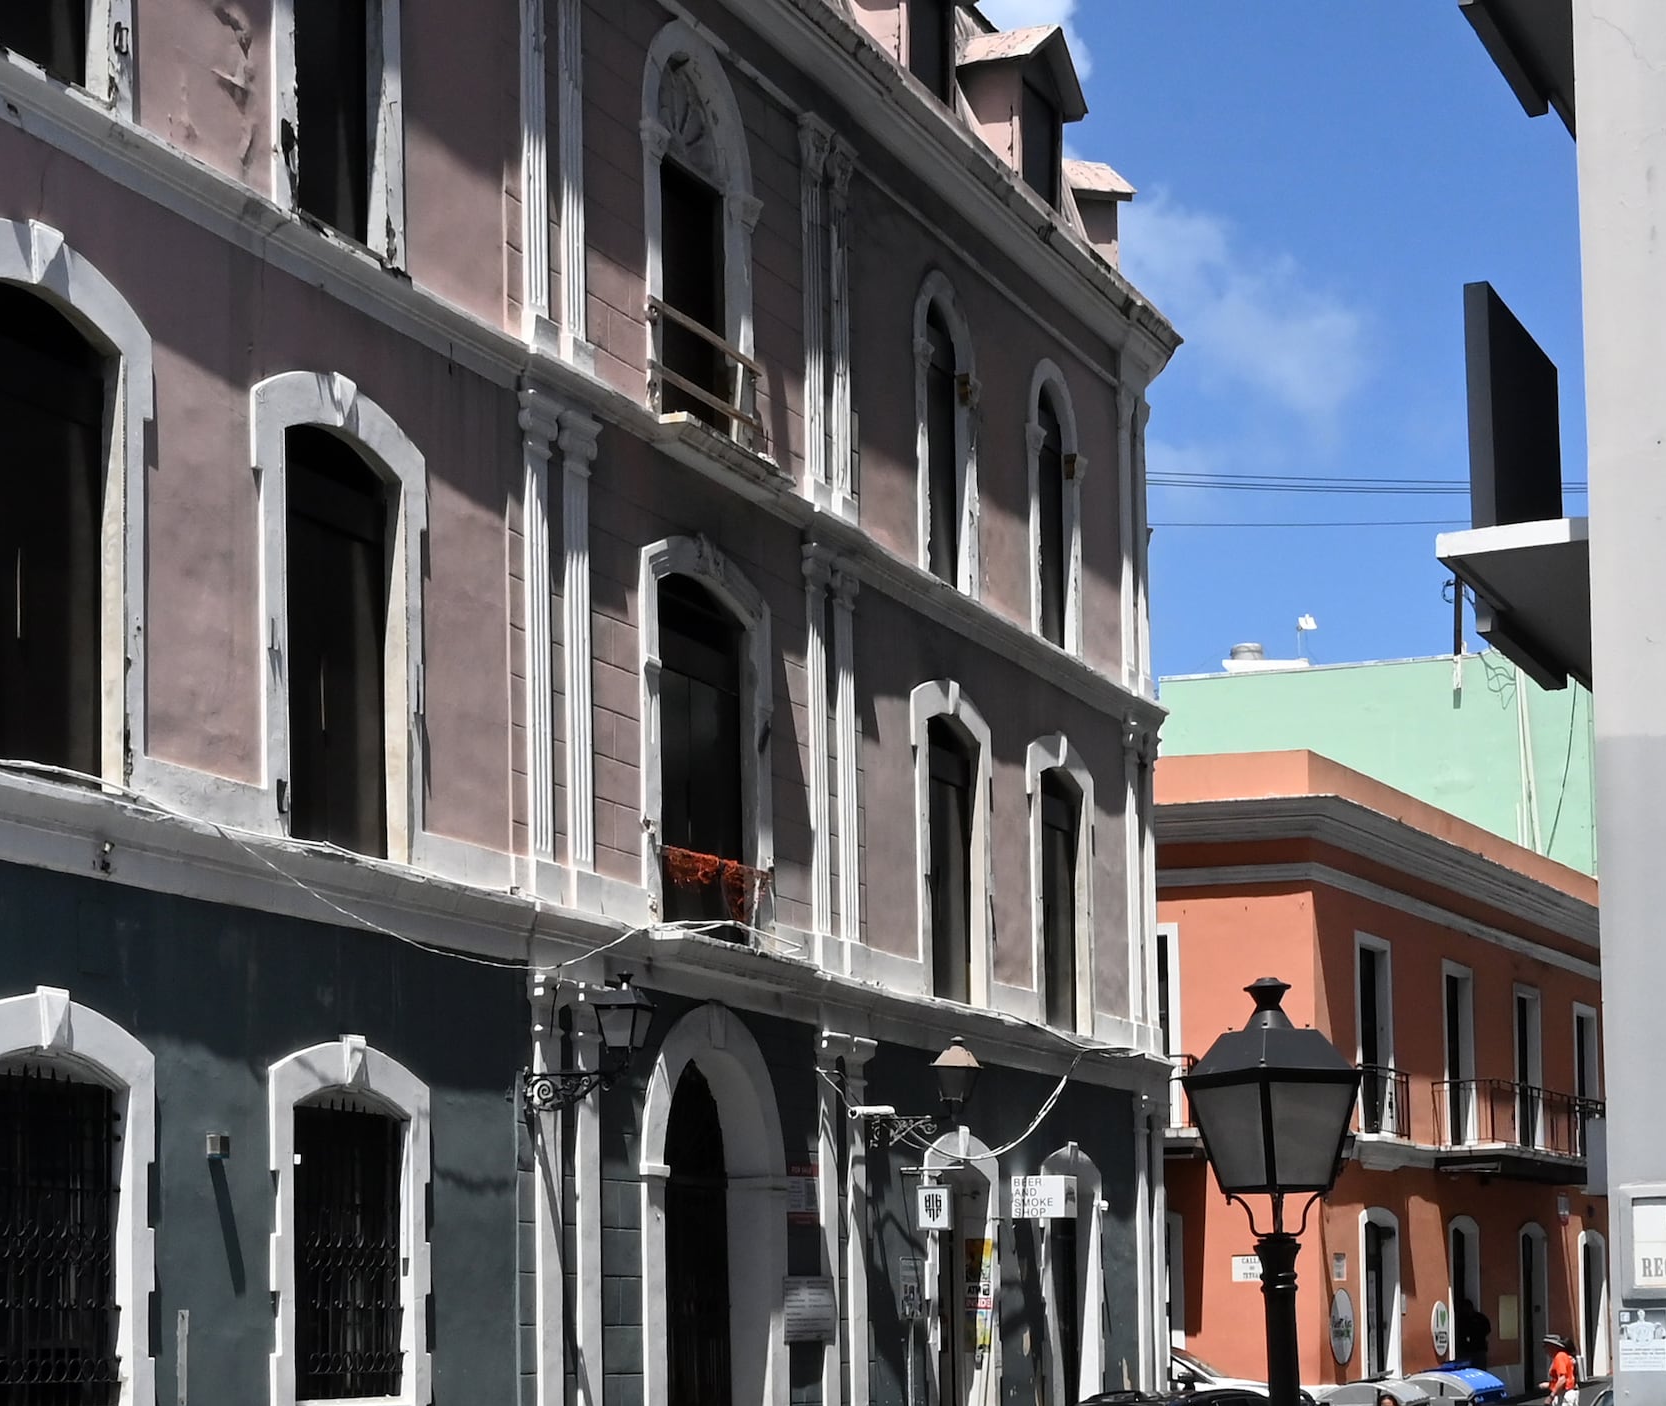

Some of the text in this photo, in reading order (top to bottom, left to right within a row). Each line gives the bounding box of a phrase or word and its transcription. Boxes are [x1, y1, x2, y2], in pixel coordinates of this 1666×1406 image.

[1014, 1178, 1042, 1187] BEER
[1015, 1188, 1037, 1197] AND
[1014, 1198, 1054, 1207] SMOKE
[1015, 1208, 1046, 1217] SHOP
